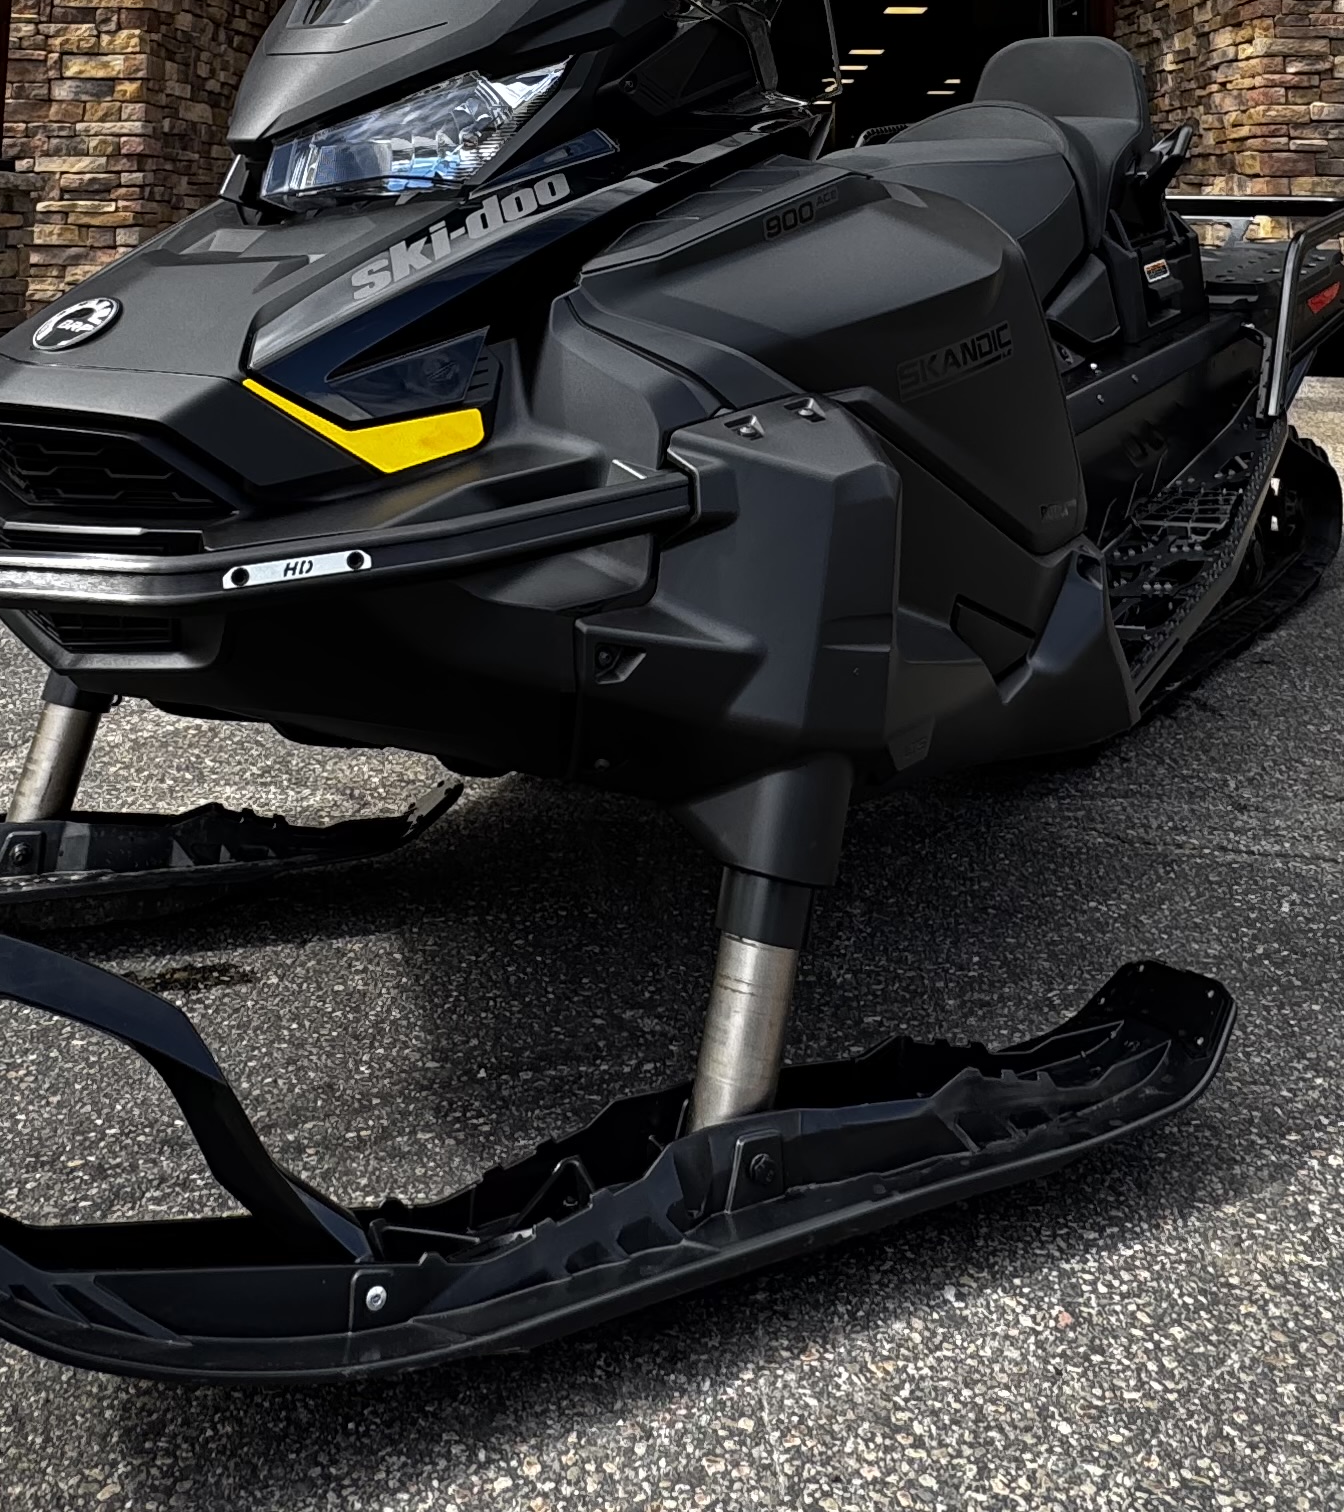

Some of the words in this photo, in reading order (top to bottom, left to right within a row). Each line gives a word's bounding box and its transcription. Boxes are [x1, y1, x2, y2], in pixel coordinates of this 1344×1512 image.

[766, 201, 814, 238] 900
[56, 319, 95, 333] BRP
[897, 322, 1012, 390] SKANDIC
[284, 560, 313, 577] HD
